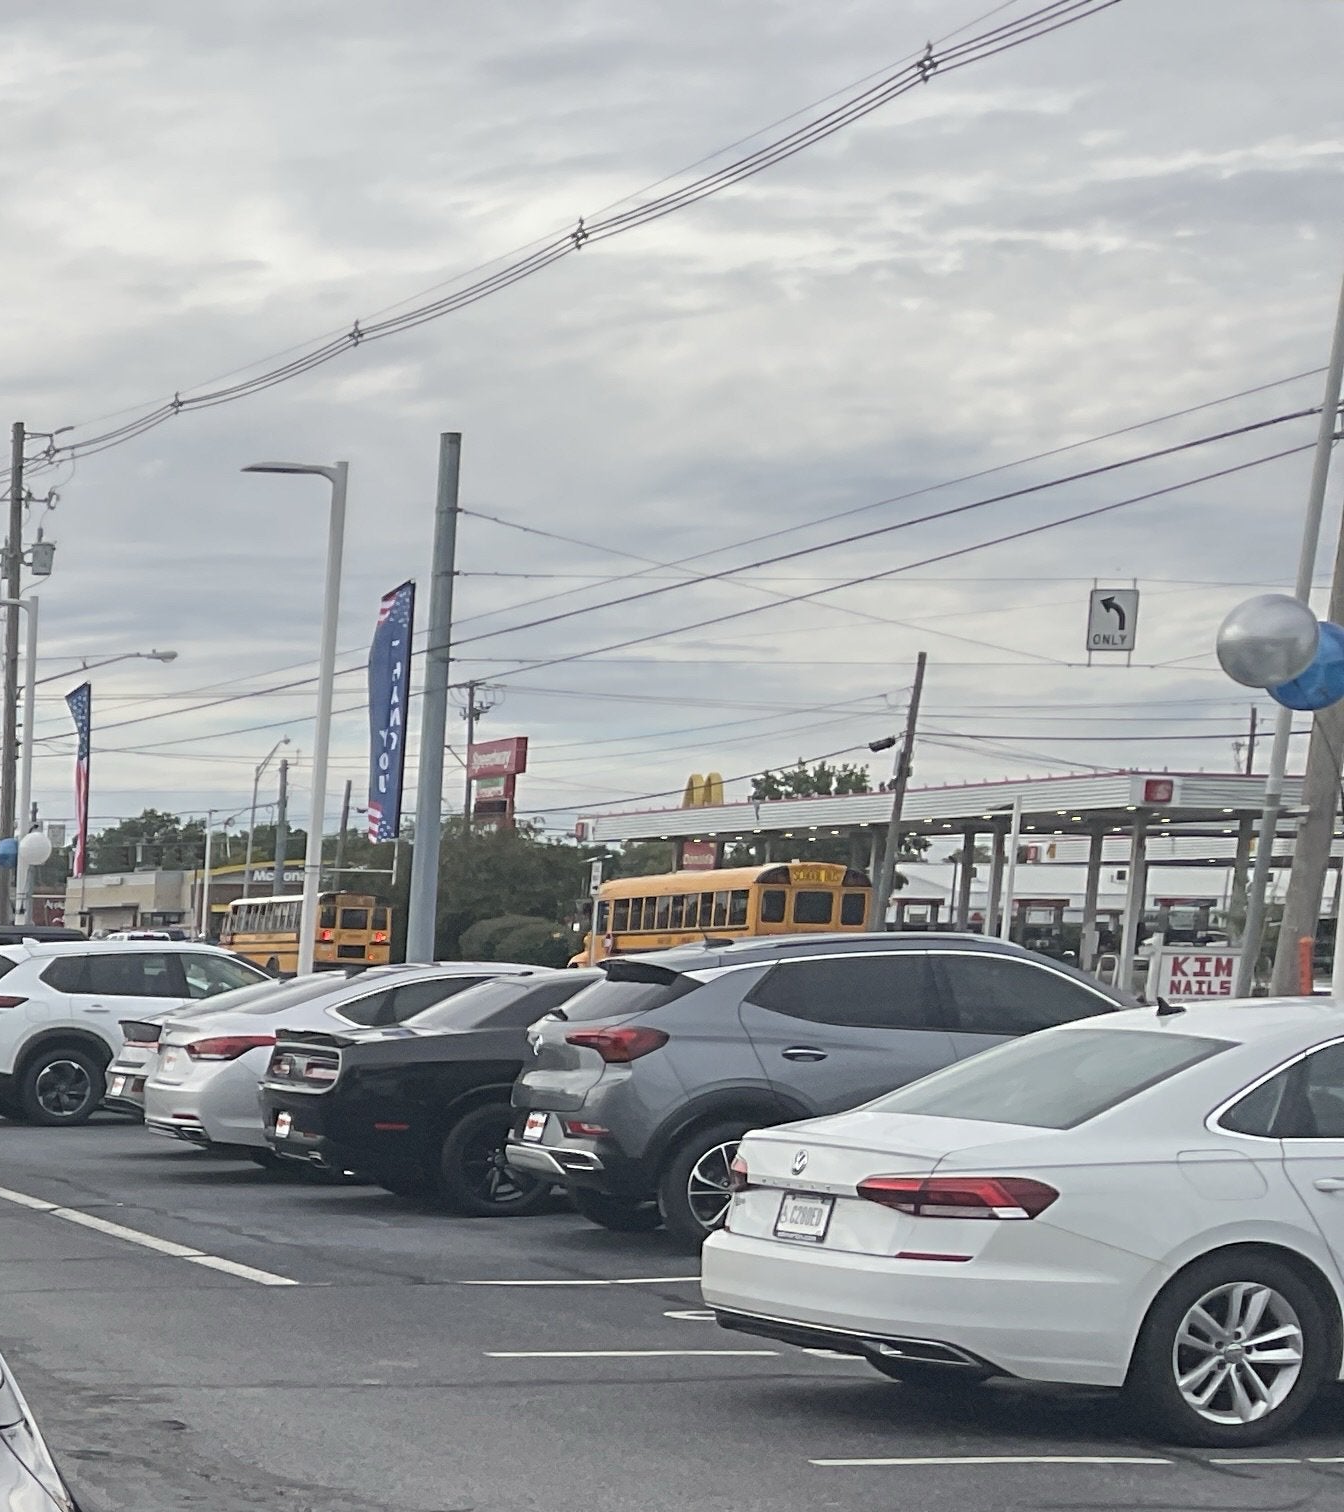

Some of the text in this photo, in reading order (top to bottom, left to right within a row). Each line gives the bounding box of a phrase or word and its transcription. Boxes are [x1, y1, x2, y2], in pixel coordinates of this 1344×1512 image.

[1093, 634, 1127, 645] ONLY
[1171, 957, 1234, 977] KIM
[1169, 980, 1231, 995] NAILS
